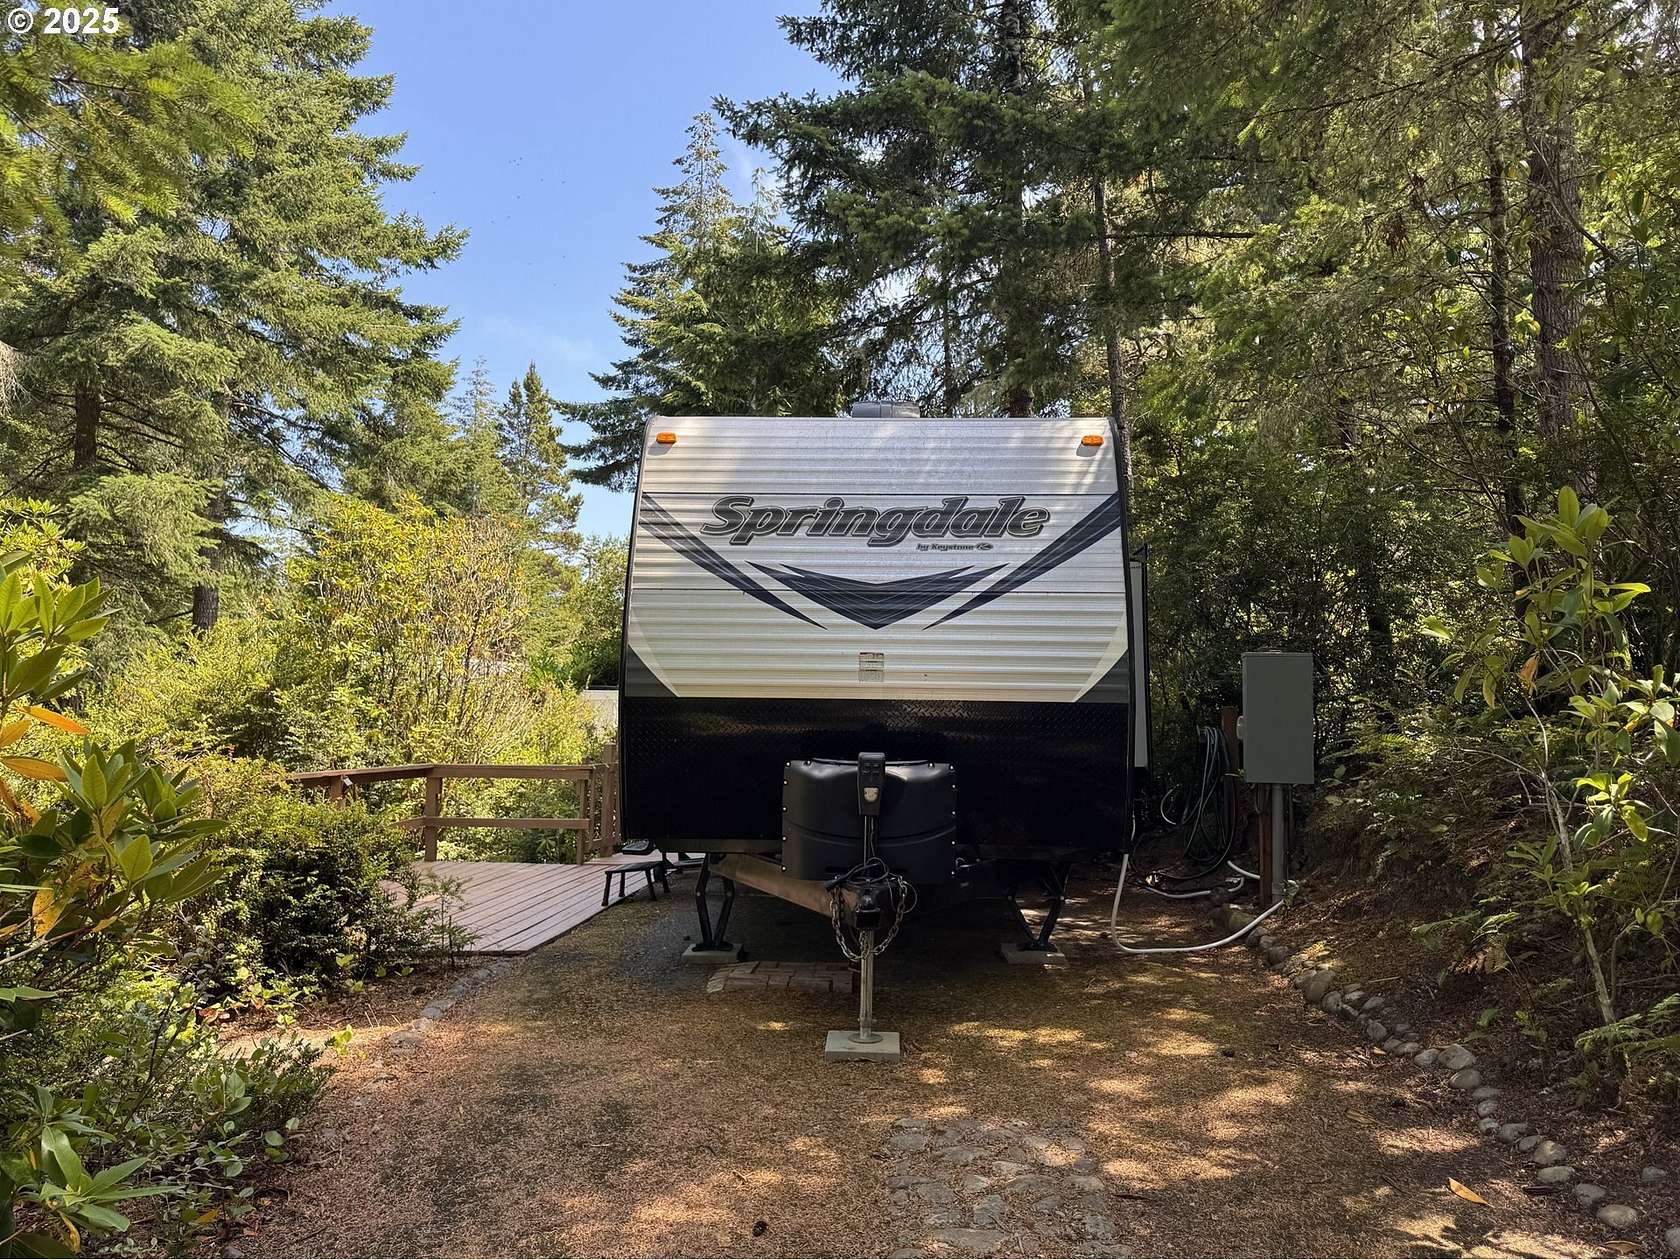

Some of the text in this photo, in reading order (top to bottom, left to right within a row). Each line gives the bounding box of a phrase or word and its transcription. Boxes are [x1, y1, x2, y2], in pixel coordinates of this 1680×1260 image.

[701, 495, 1050, 546] Springdale
[916, 543, 974, 551] by Keystone
